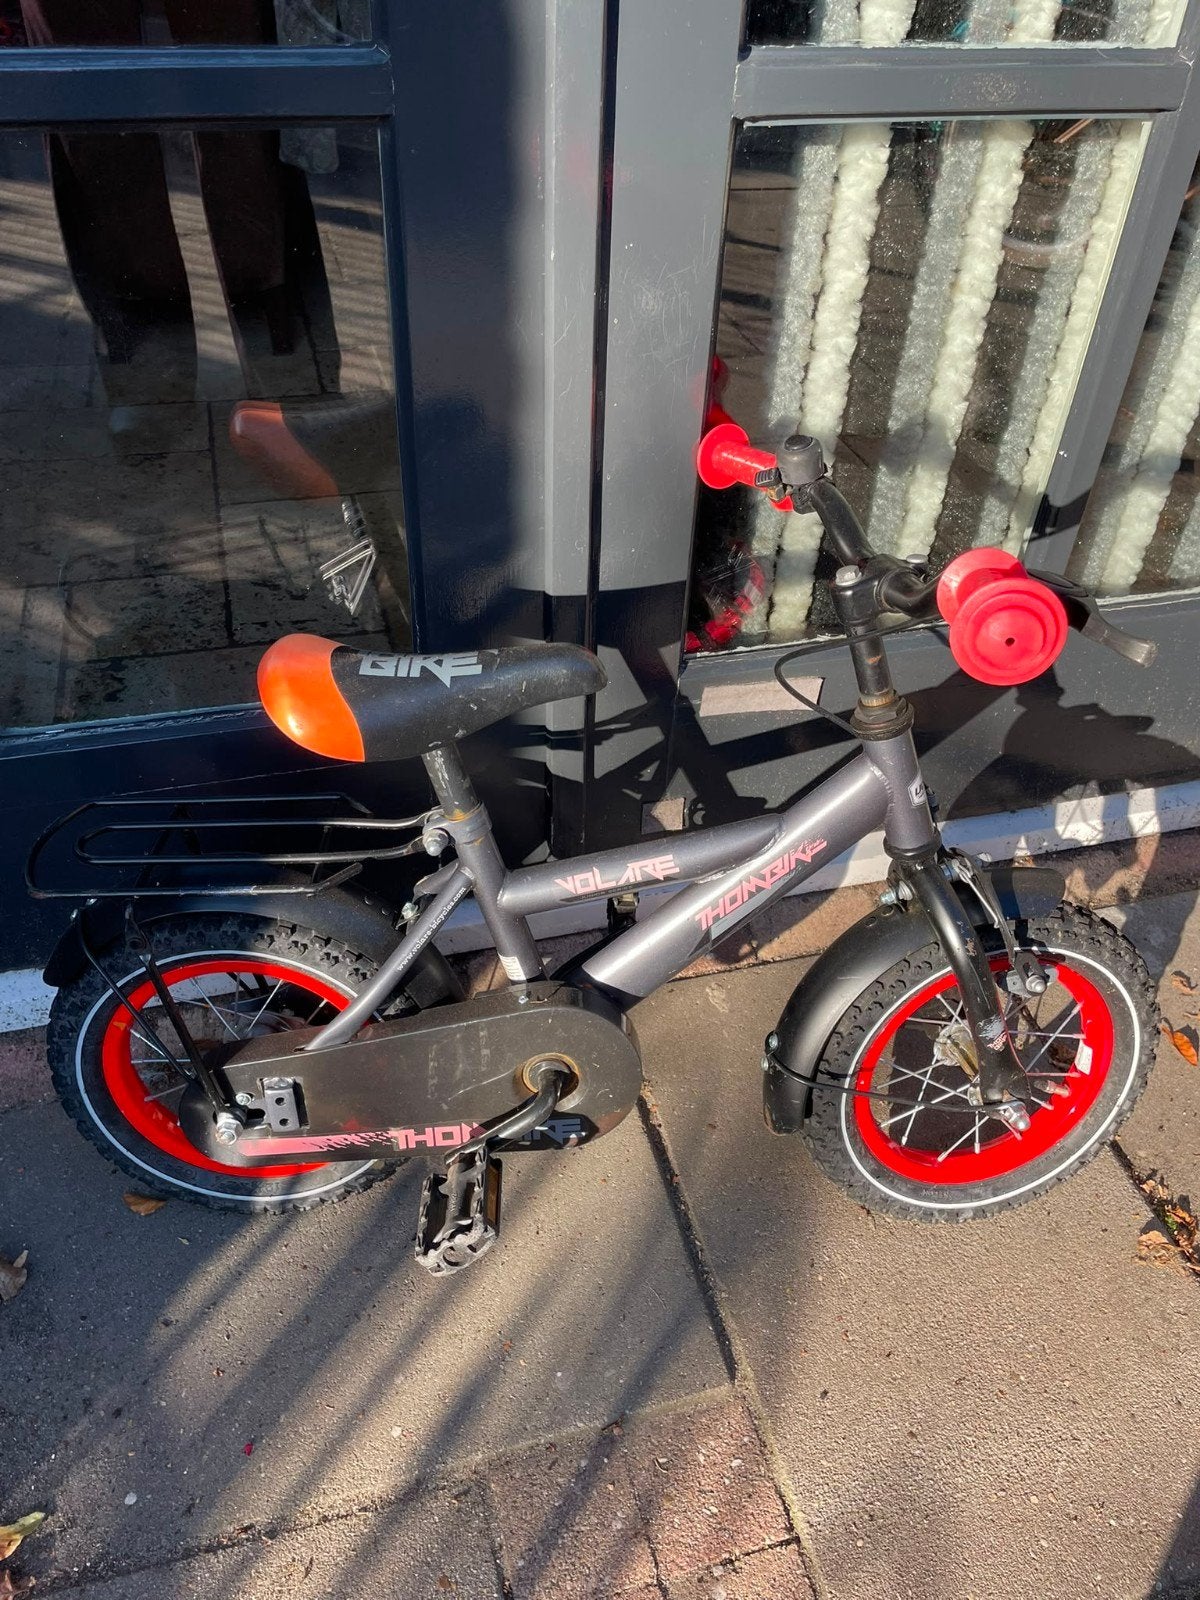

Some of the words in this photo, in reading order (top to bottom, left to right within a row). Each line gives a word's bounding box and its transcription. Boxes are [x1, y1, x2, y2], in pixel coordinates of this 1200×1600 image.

[359, 651, 483, 688] BIKE
[554, 854, 680, 895] VOLARE
[397, 887, 466, 971] www.volare-bicycles.com
